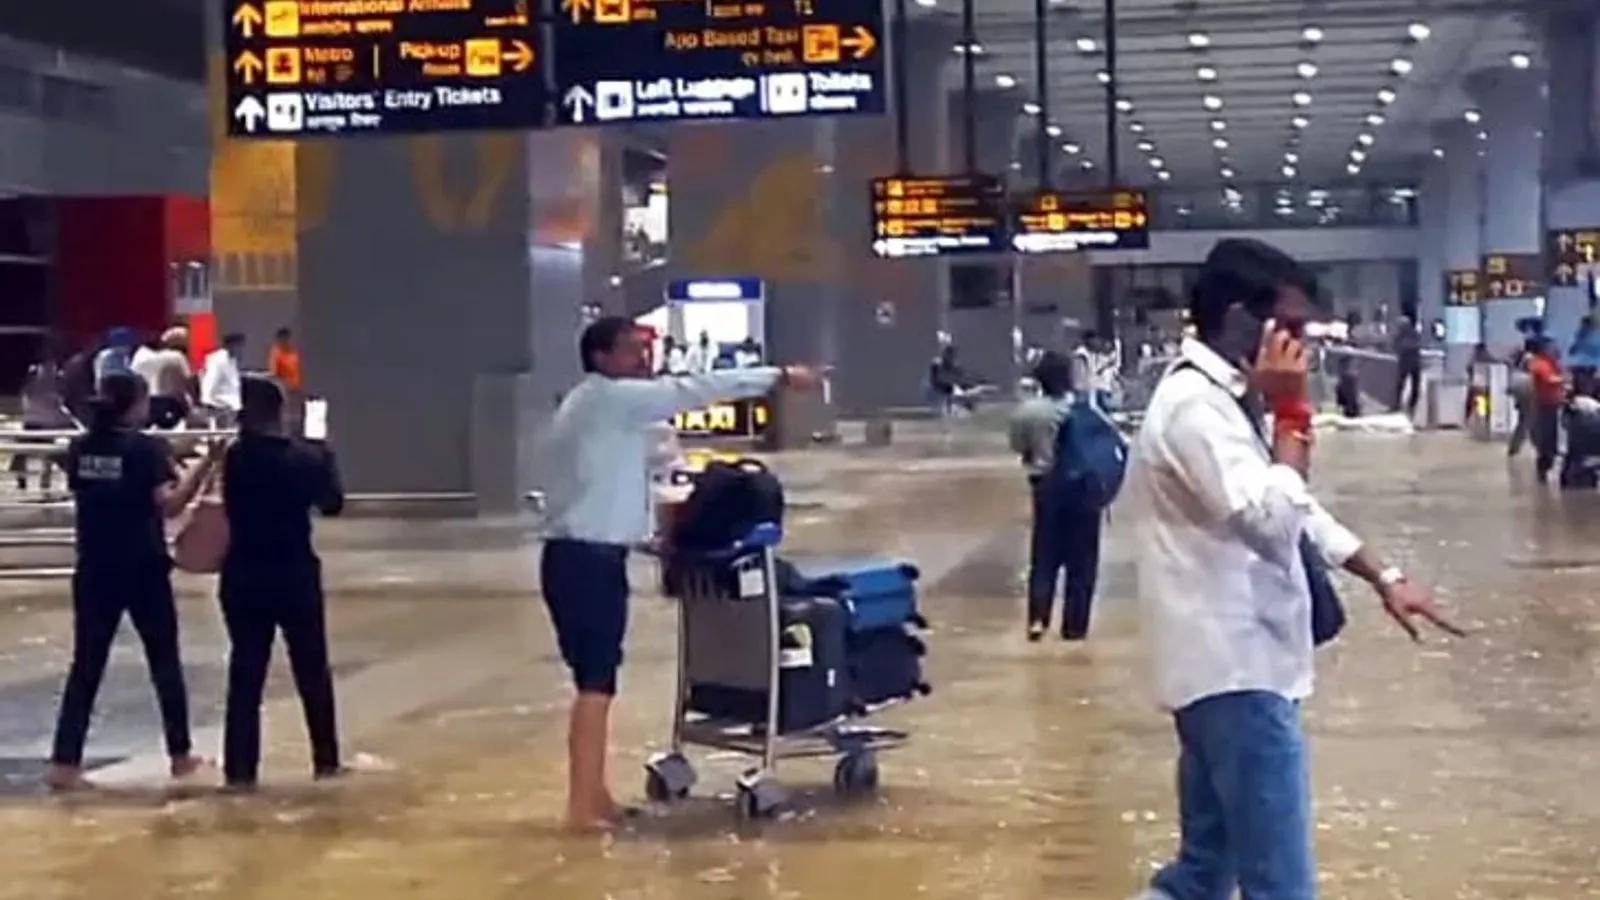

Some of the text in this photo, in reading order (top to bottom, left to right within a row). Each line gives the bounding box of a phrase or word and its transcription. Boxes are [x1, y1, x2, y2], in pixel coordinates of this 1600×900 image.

[664, 26, 798, 48] App Based Taxi
[304, 47, 354, 62] Metro
[636, 77, 755, 99] Left Luggage
[809, 71, 872, 91] Toilets
[384, 90, 433, 109] Entry
[437, 86, 501, 105] Tickets
